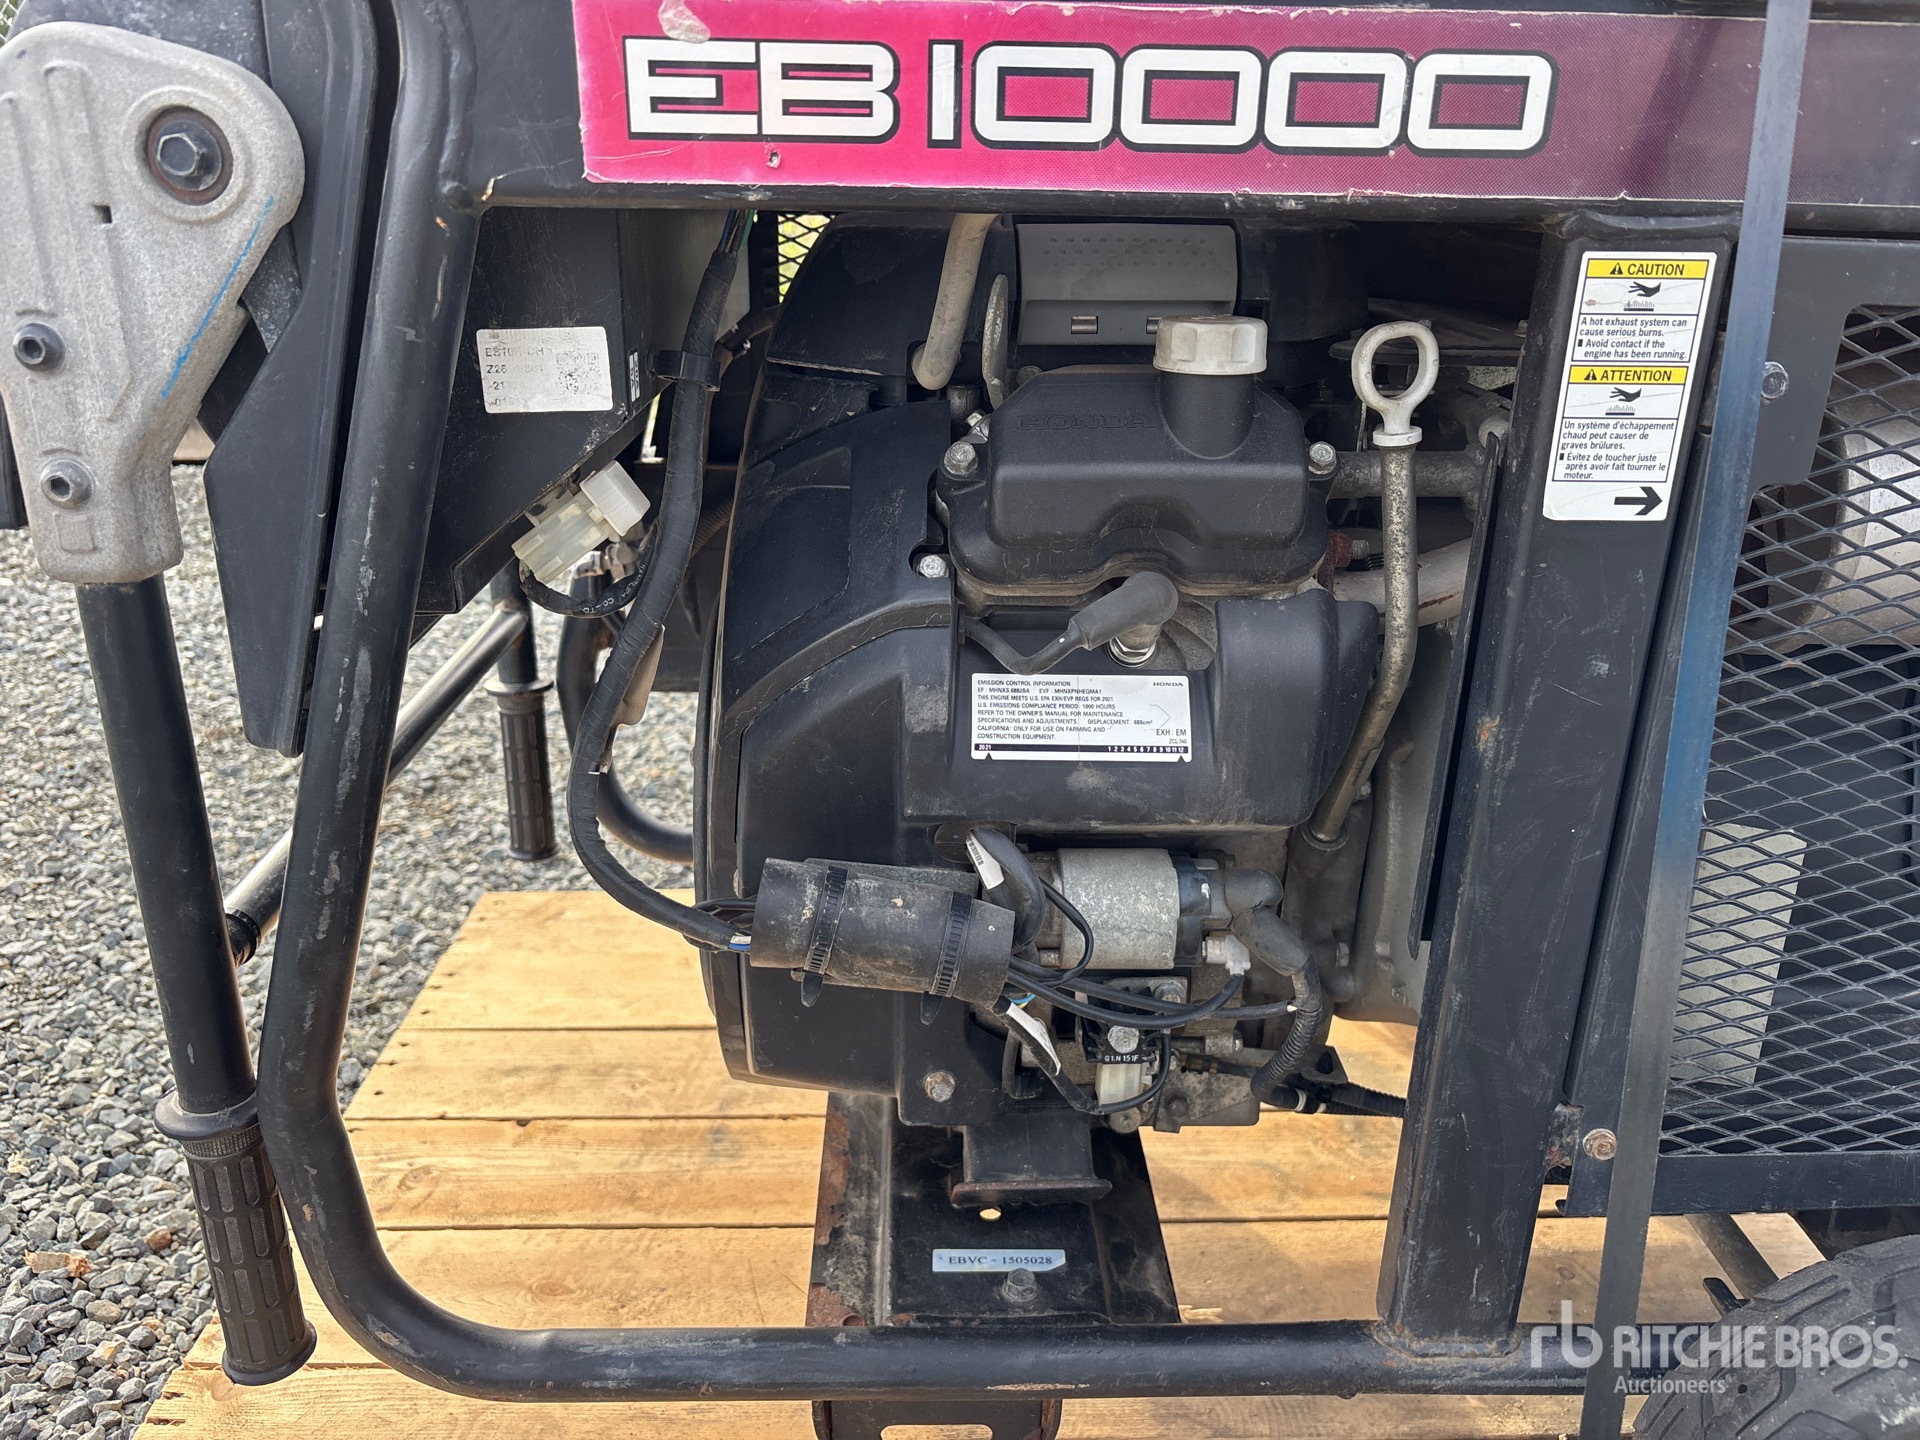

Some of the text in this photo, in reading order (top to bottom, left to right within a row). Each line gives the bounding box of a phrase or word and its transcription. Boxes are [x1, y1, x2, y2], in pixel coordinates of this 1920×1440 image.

[622, 36, 1558, 157] EB10000
[1628, 264, 1685, 275] CAUTION
[1590, 318, 1603, 326] hot
[1605, 318, 1638, 326] exhaust
[1640, 319, 1669, 328] system
[1606, 328, 1636, 336] serious
[1638, 328, 1664, 337] burns.
[1585, 339, 1665, 348] Avoid contact if the
[1584, 350, 1687, 360] engine has been running.
[1600, 370, 1672, 382] ATTENTION
[1017, 415, 1156, 431] HONDA
[1577, 421, 1610, 431] système
[1612, 421, 1674, 432] d'échappement
[1562, 431, 1587, 439] chaud
[1589, 432, 1607, 441] peut
[1639, 432, 1649, 440] de
[1561, 441, 1625, 450] graves brûlures.
[1567, 452, 1657, 463] Évitez de toucher juste
[1566, 463, 1588, 472] après
[1611, 462, 1625, 471] fait
[1627, 463, 1657, 471] tourner
[1659, 463, 1666, 471] le
